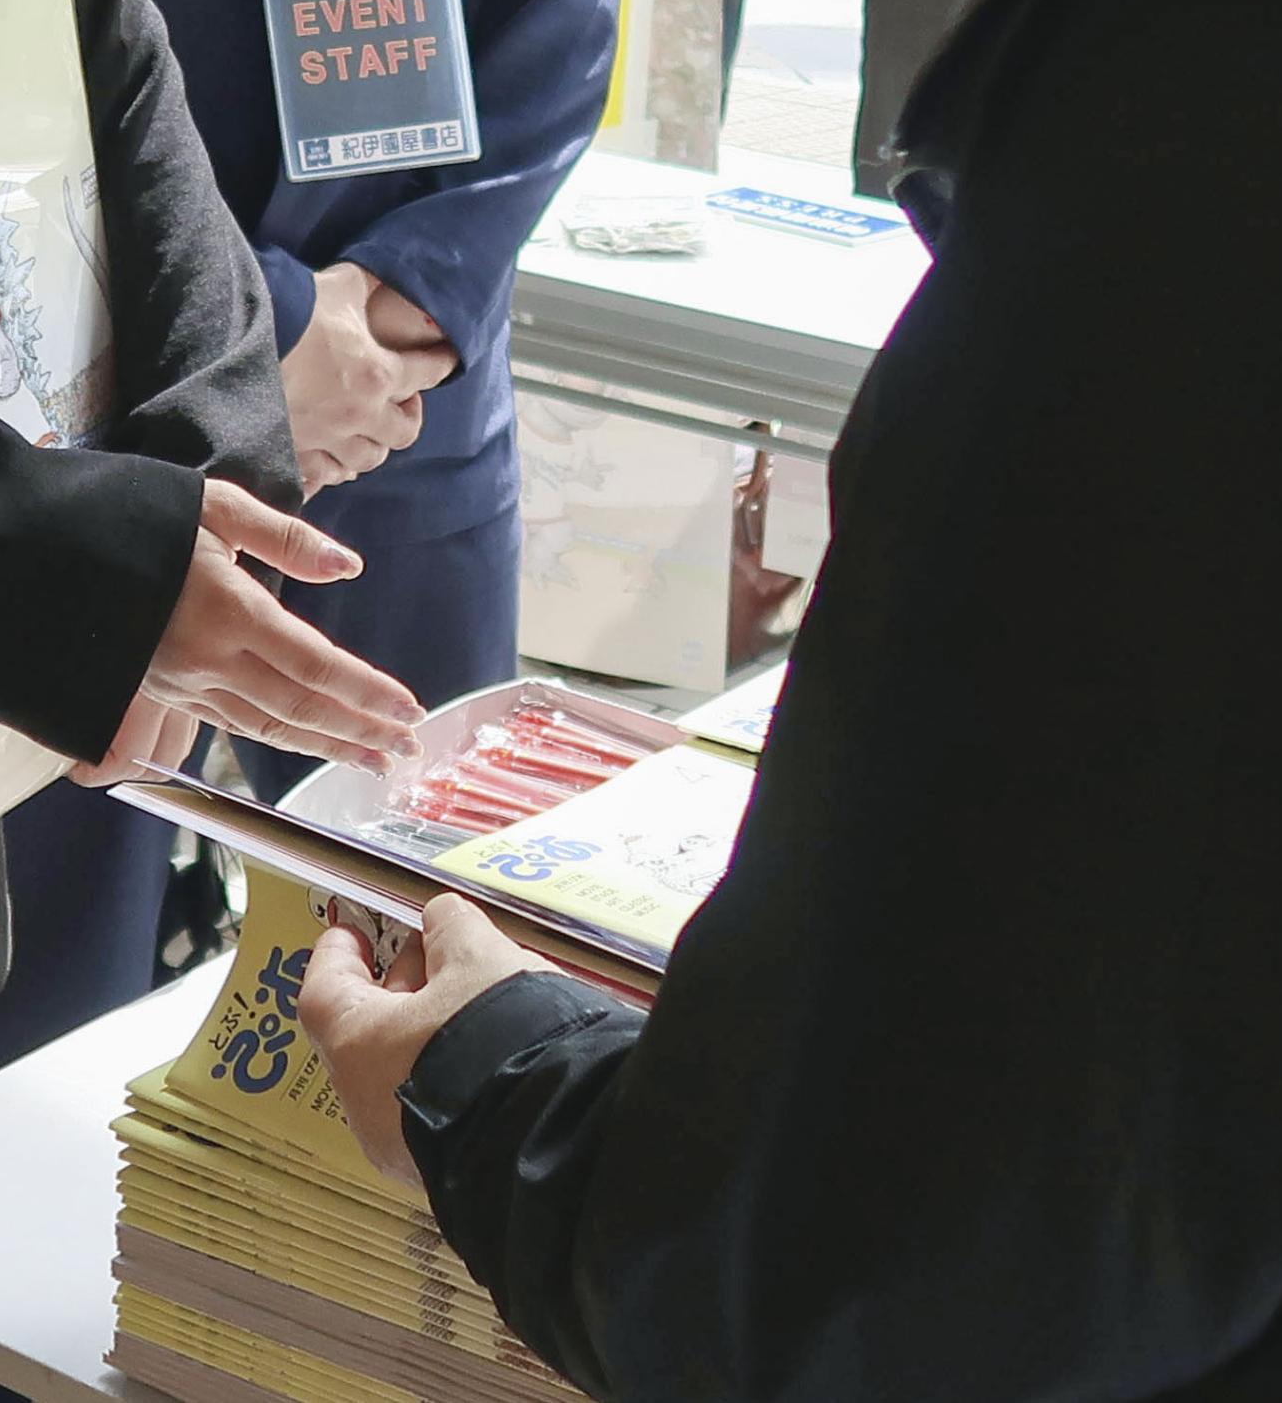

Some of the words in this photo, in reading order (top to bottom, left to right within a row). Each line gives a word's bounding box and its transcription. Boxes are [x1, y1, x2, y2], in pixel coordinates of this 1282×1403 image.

[300, 36, 438, 85] STAFF
[341, 126, 459, 161] 紀伊國屋書店
[476, 834, 603, 882] ぴあ
[310, 1078, 333, 1112] MOV
